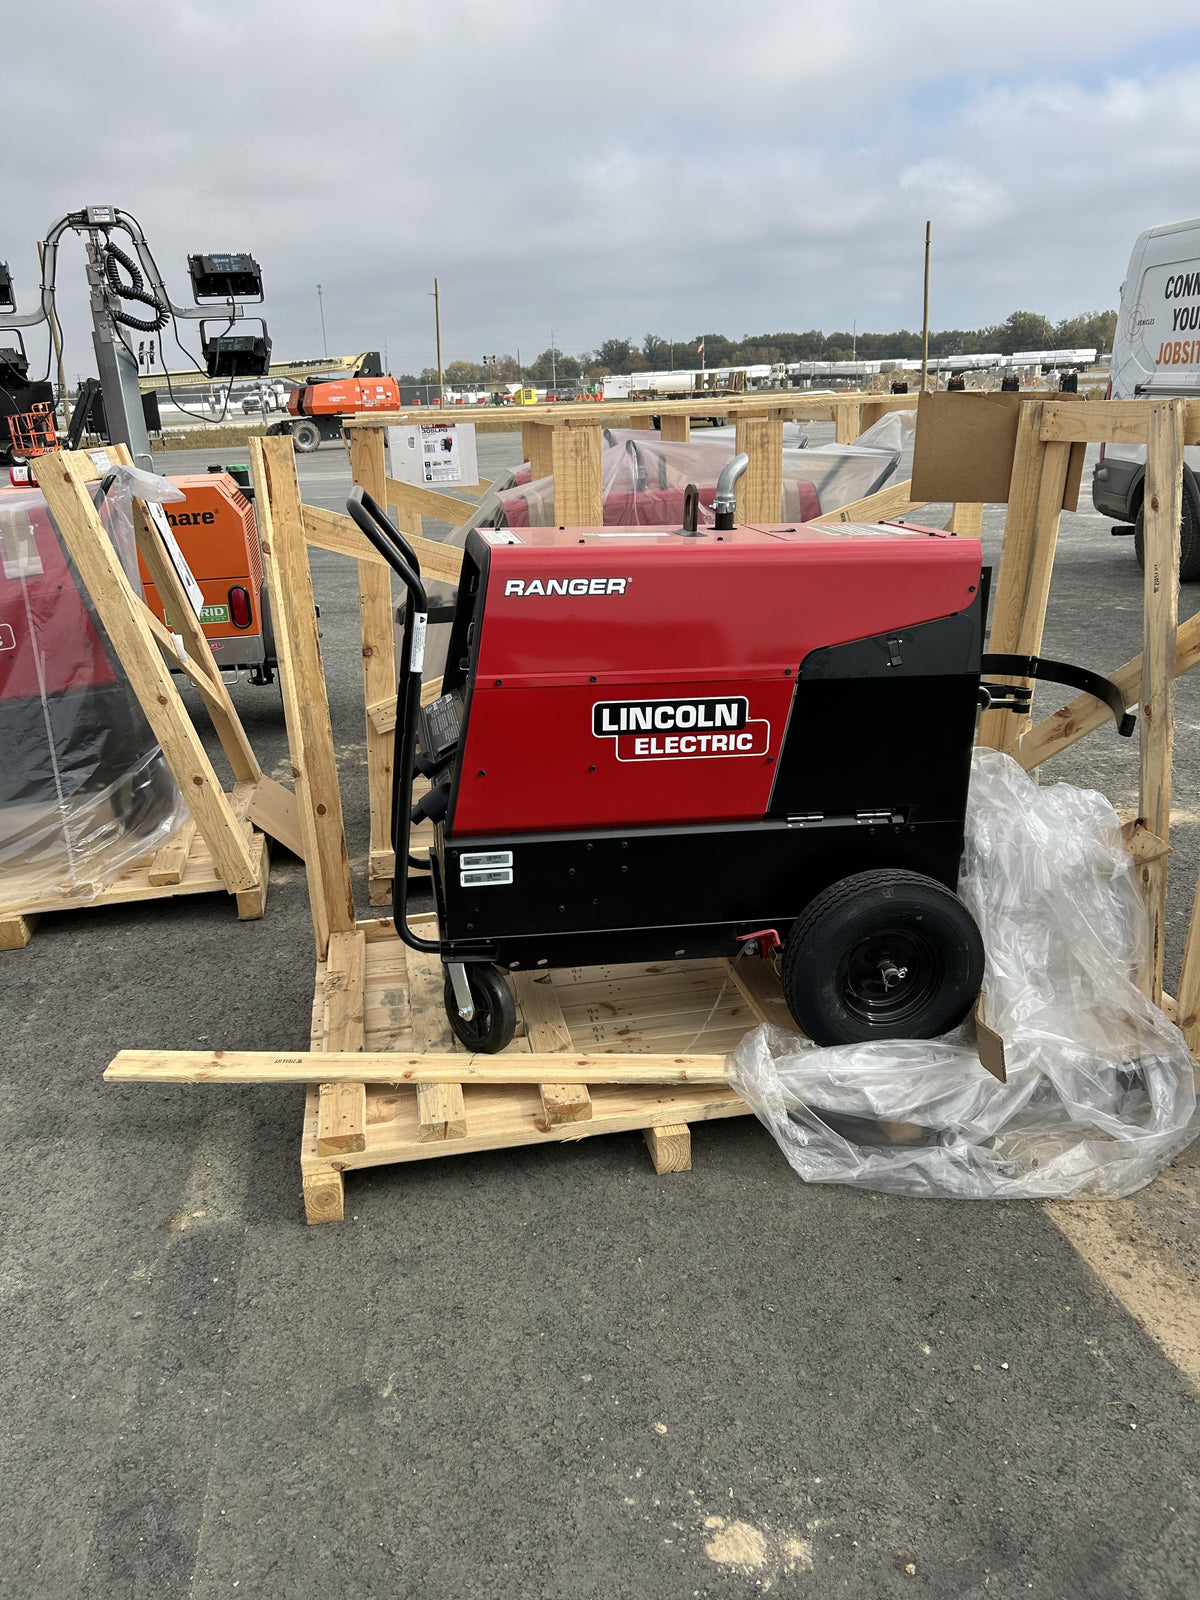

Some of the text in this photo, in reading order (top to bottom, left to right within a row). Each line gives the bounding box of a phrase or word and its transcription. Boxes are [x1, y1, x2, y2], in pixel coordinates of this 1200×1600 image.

[1173, 306, 1200, 331] YOU
[504, 578, 626, 597] RANGER
[602, 703, 738, 731] LINCOLN
[634, 733, 753, 755] ELECTRIC
